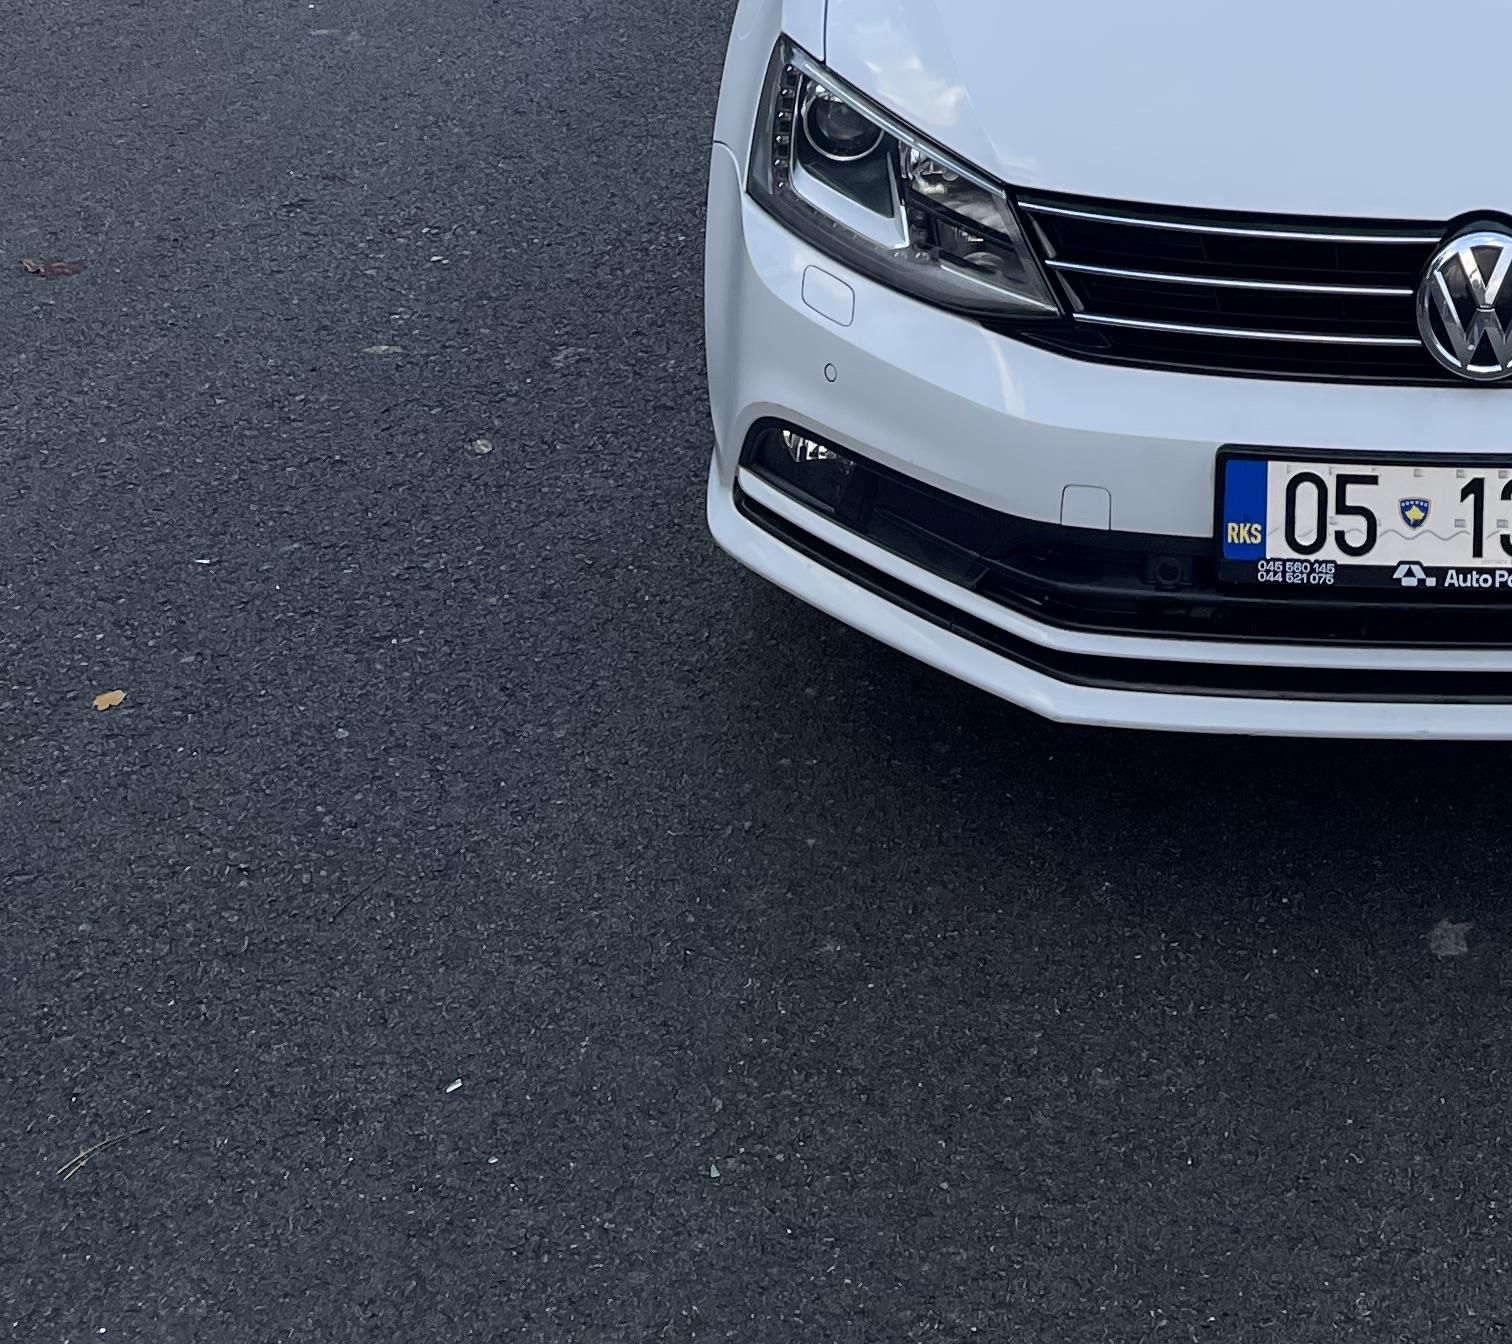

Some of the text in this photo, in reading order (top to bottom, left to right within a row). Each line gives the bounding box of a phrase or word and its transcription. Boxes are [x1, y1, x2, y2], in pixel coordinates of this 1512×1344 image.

[1285, 472, 1380, 556] 05
[1227, 522, 1262, 544] RKS
[1257, 560, 1335, 574] 045 560 145
[1257, 571, 1282, 582] 044
[1285, 572, 1307, 583] 521
